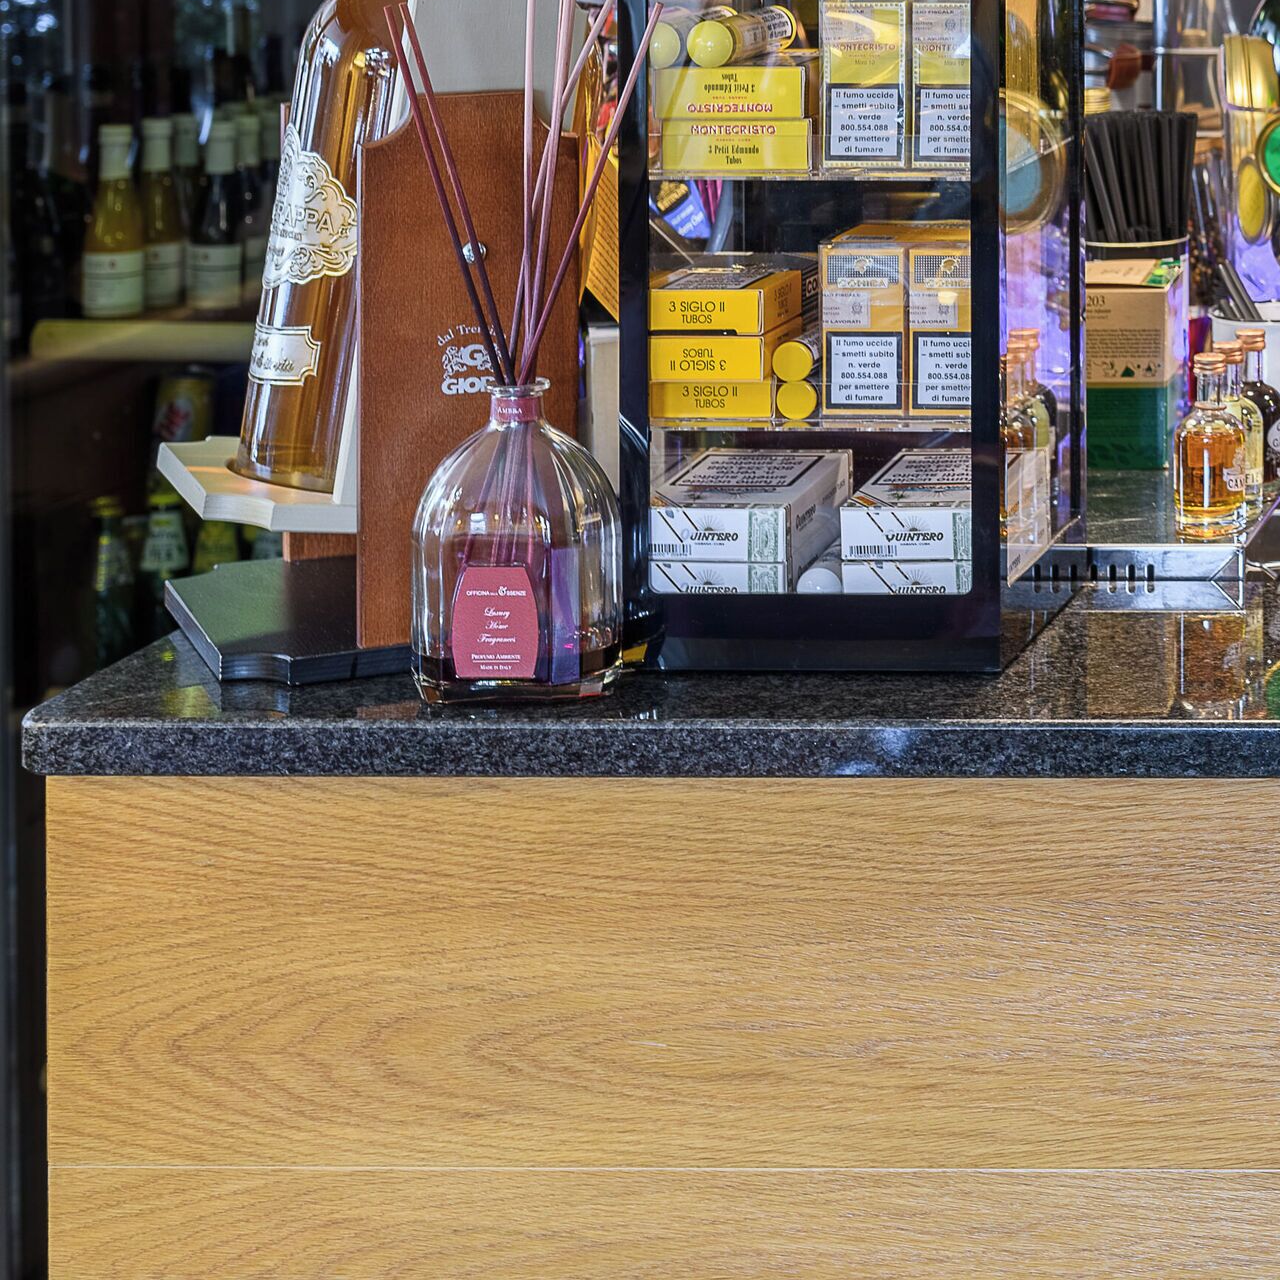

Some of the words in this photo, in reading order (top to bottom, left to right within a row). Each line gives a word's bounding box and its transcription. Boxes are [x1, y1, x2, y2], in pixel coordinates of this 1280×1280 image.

[721, 73, 738, 82] Tubos
[704, 83, 732, 94] Edmundo
[733, 82, 750, 93] Petit
[687, 103, 774, 113] MONTECRISTO
[858, 113, 882, 121] verde
[947, 113, 970, 121] verde
[690, 125, 776, 135] MONTECRISTO
[840, 124, 889, 132] 800.554.088
[854, 135, 890, 143] smettere
[714, 144, 729, 154] Petit
[731, 144, 760, 154] Edmundo
[273, 200, 335, 234] RAPPA
[668, 301, 677, 313] 3
[680, 301, 716, 313] SIGLO
[682, 314, 713, 324] TUBOS
[437, 328, 455, 347] dal
[843, 339, 864, 347] fumo
[682, 348, 714, 358] TUBOS
[680, 359, 716, 371] SIGLO
[719, 359, 727, 371] 3
[858, 361, 881, 369] verde
[840, 372, 889, 380] 800.554.088
[682, 385, 690, 397] 3
[693, 385, 729, 397] SIGLO
[854, 383, 890, 391] smettere
[695, 398, 726, 408] TUBOS
[497, 406, 523, 414] AMBRA
[885, 531, 944, 542] QUINTERO
